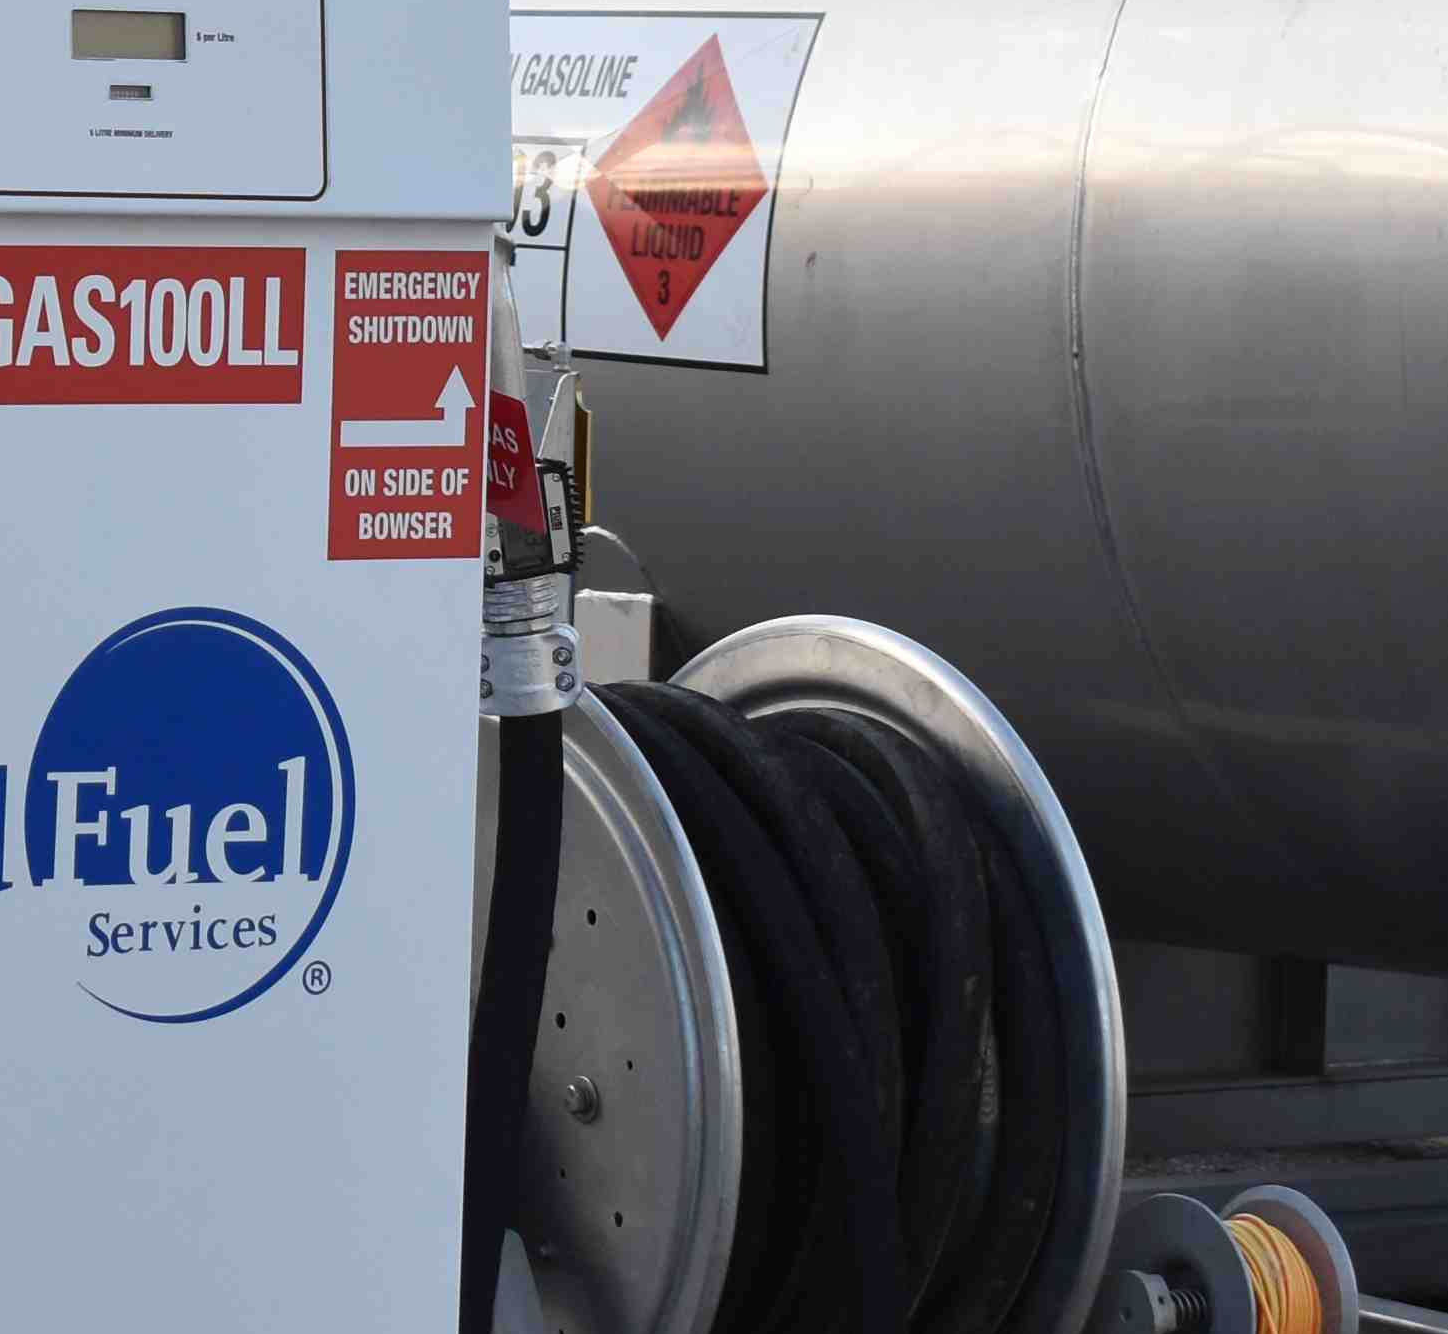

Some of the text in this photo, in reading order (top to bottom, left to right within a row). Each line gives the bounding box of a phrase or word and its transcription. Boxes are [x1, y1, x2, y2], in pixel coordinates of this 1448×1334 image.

[520, 53, 638, 98] GASOLINE
[631, 220, 705, 262] LIQUID
[344, 272, 480, 301] EMERGENCY
[657, 269, 671, 306] 3
[348, 315, 474, 344] SHUTDOWN
[345, 468, 469, 497] ON SIDE OF
[358, 512, 452, 540] BOWSER
[33, 755, 321, 886] Fuel
[86, 904, 278, 959] Services
